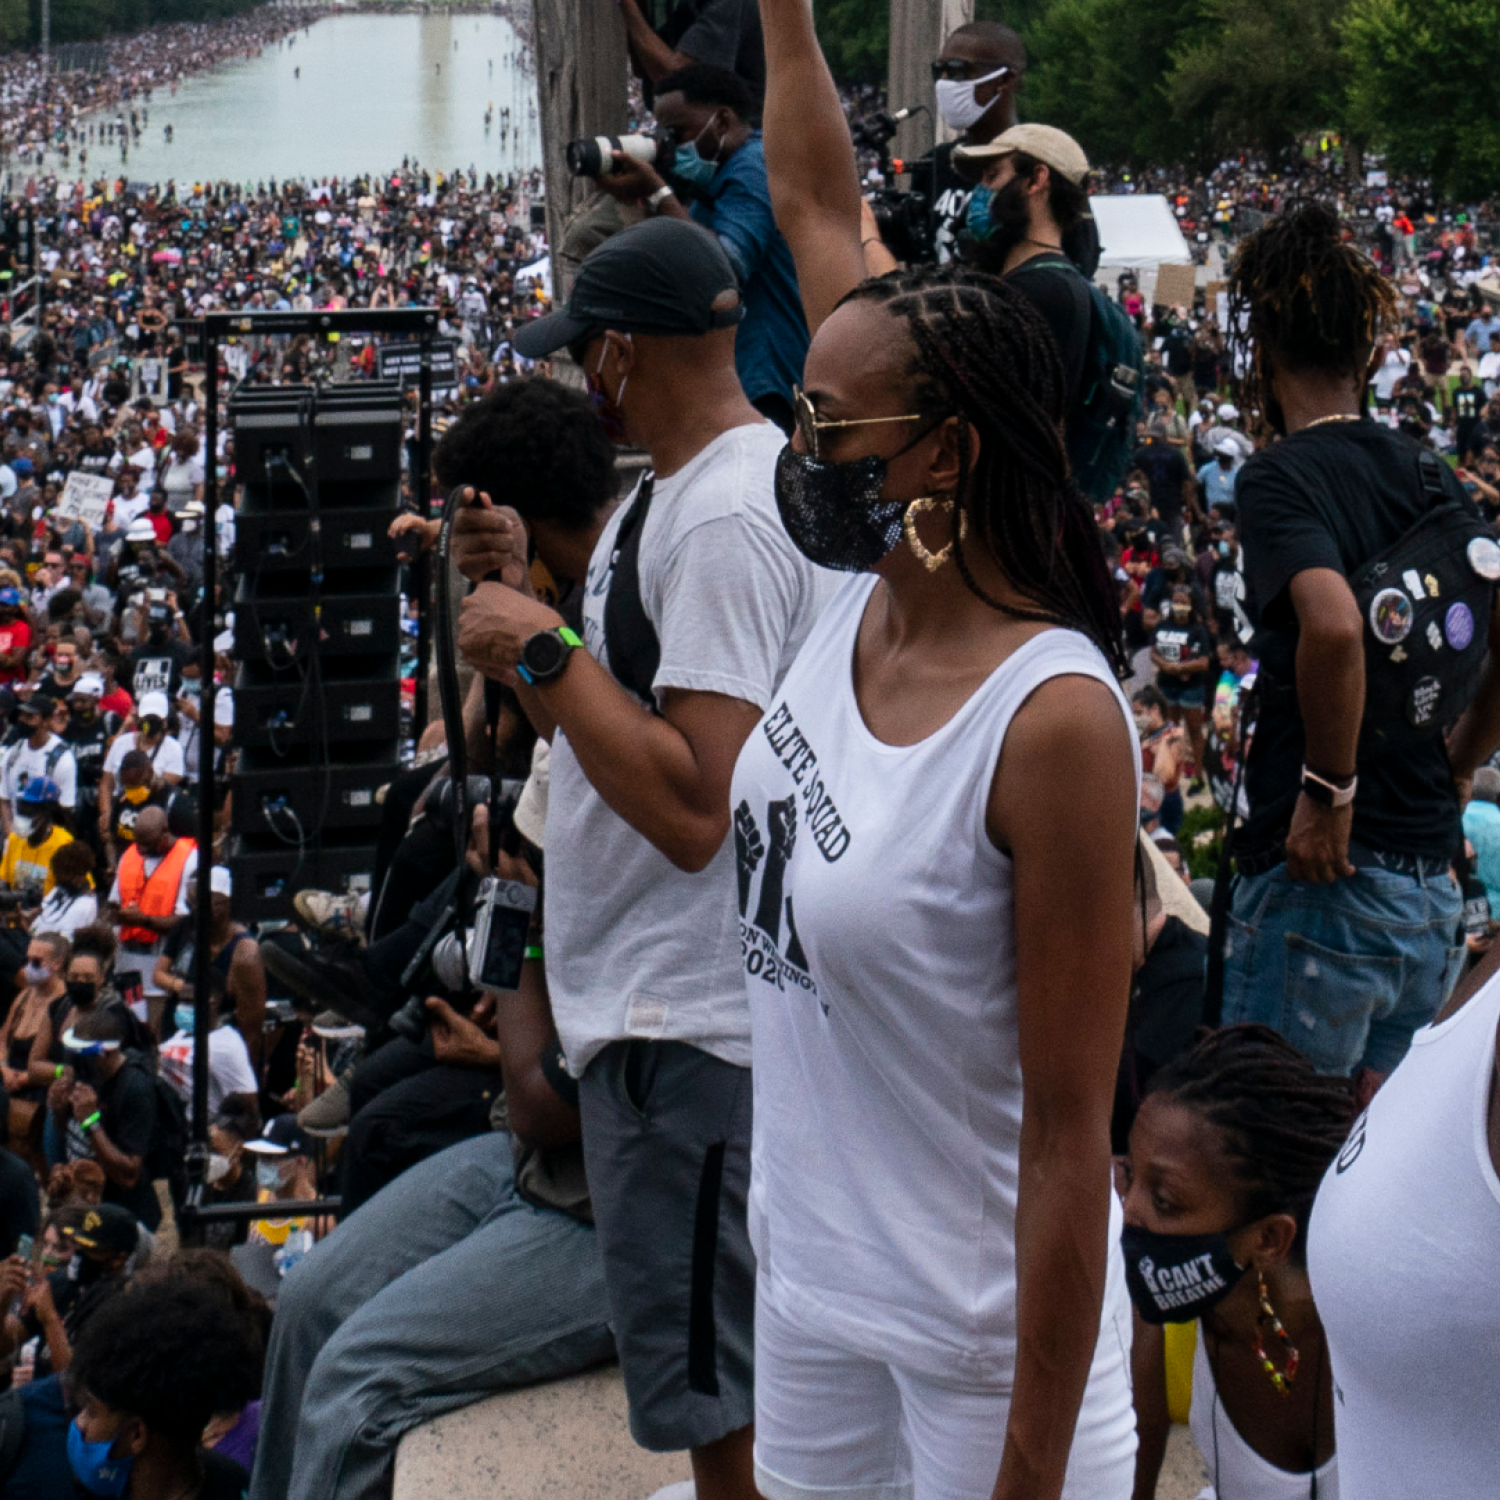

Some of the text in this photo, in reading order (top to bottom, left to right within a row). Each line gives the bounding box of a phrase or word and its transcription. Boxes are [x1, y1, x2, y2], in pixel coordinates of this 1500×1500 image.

[763, 700, 852, 863] ELITE SQUAD
[1157, 1252, 1217, 1292] CAN'T
[1152, 1276, 1227, 1312] BREATHE
